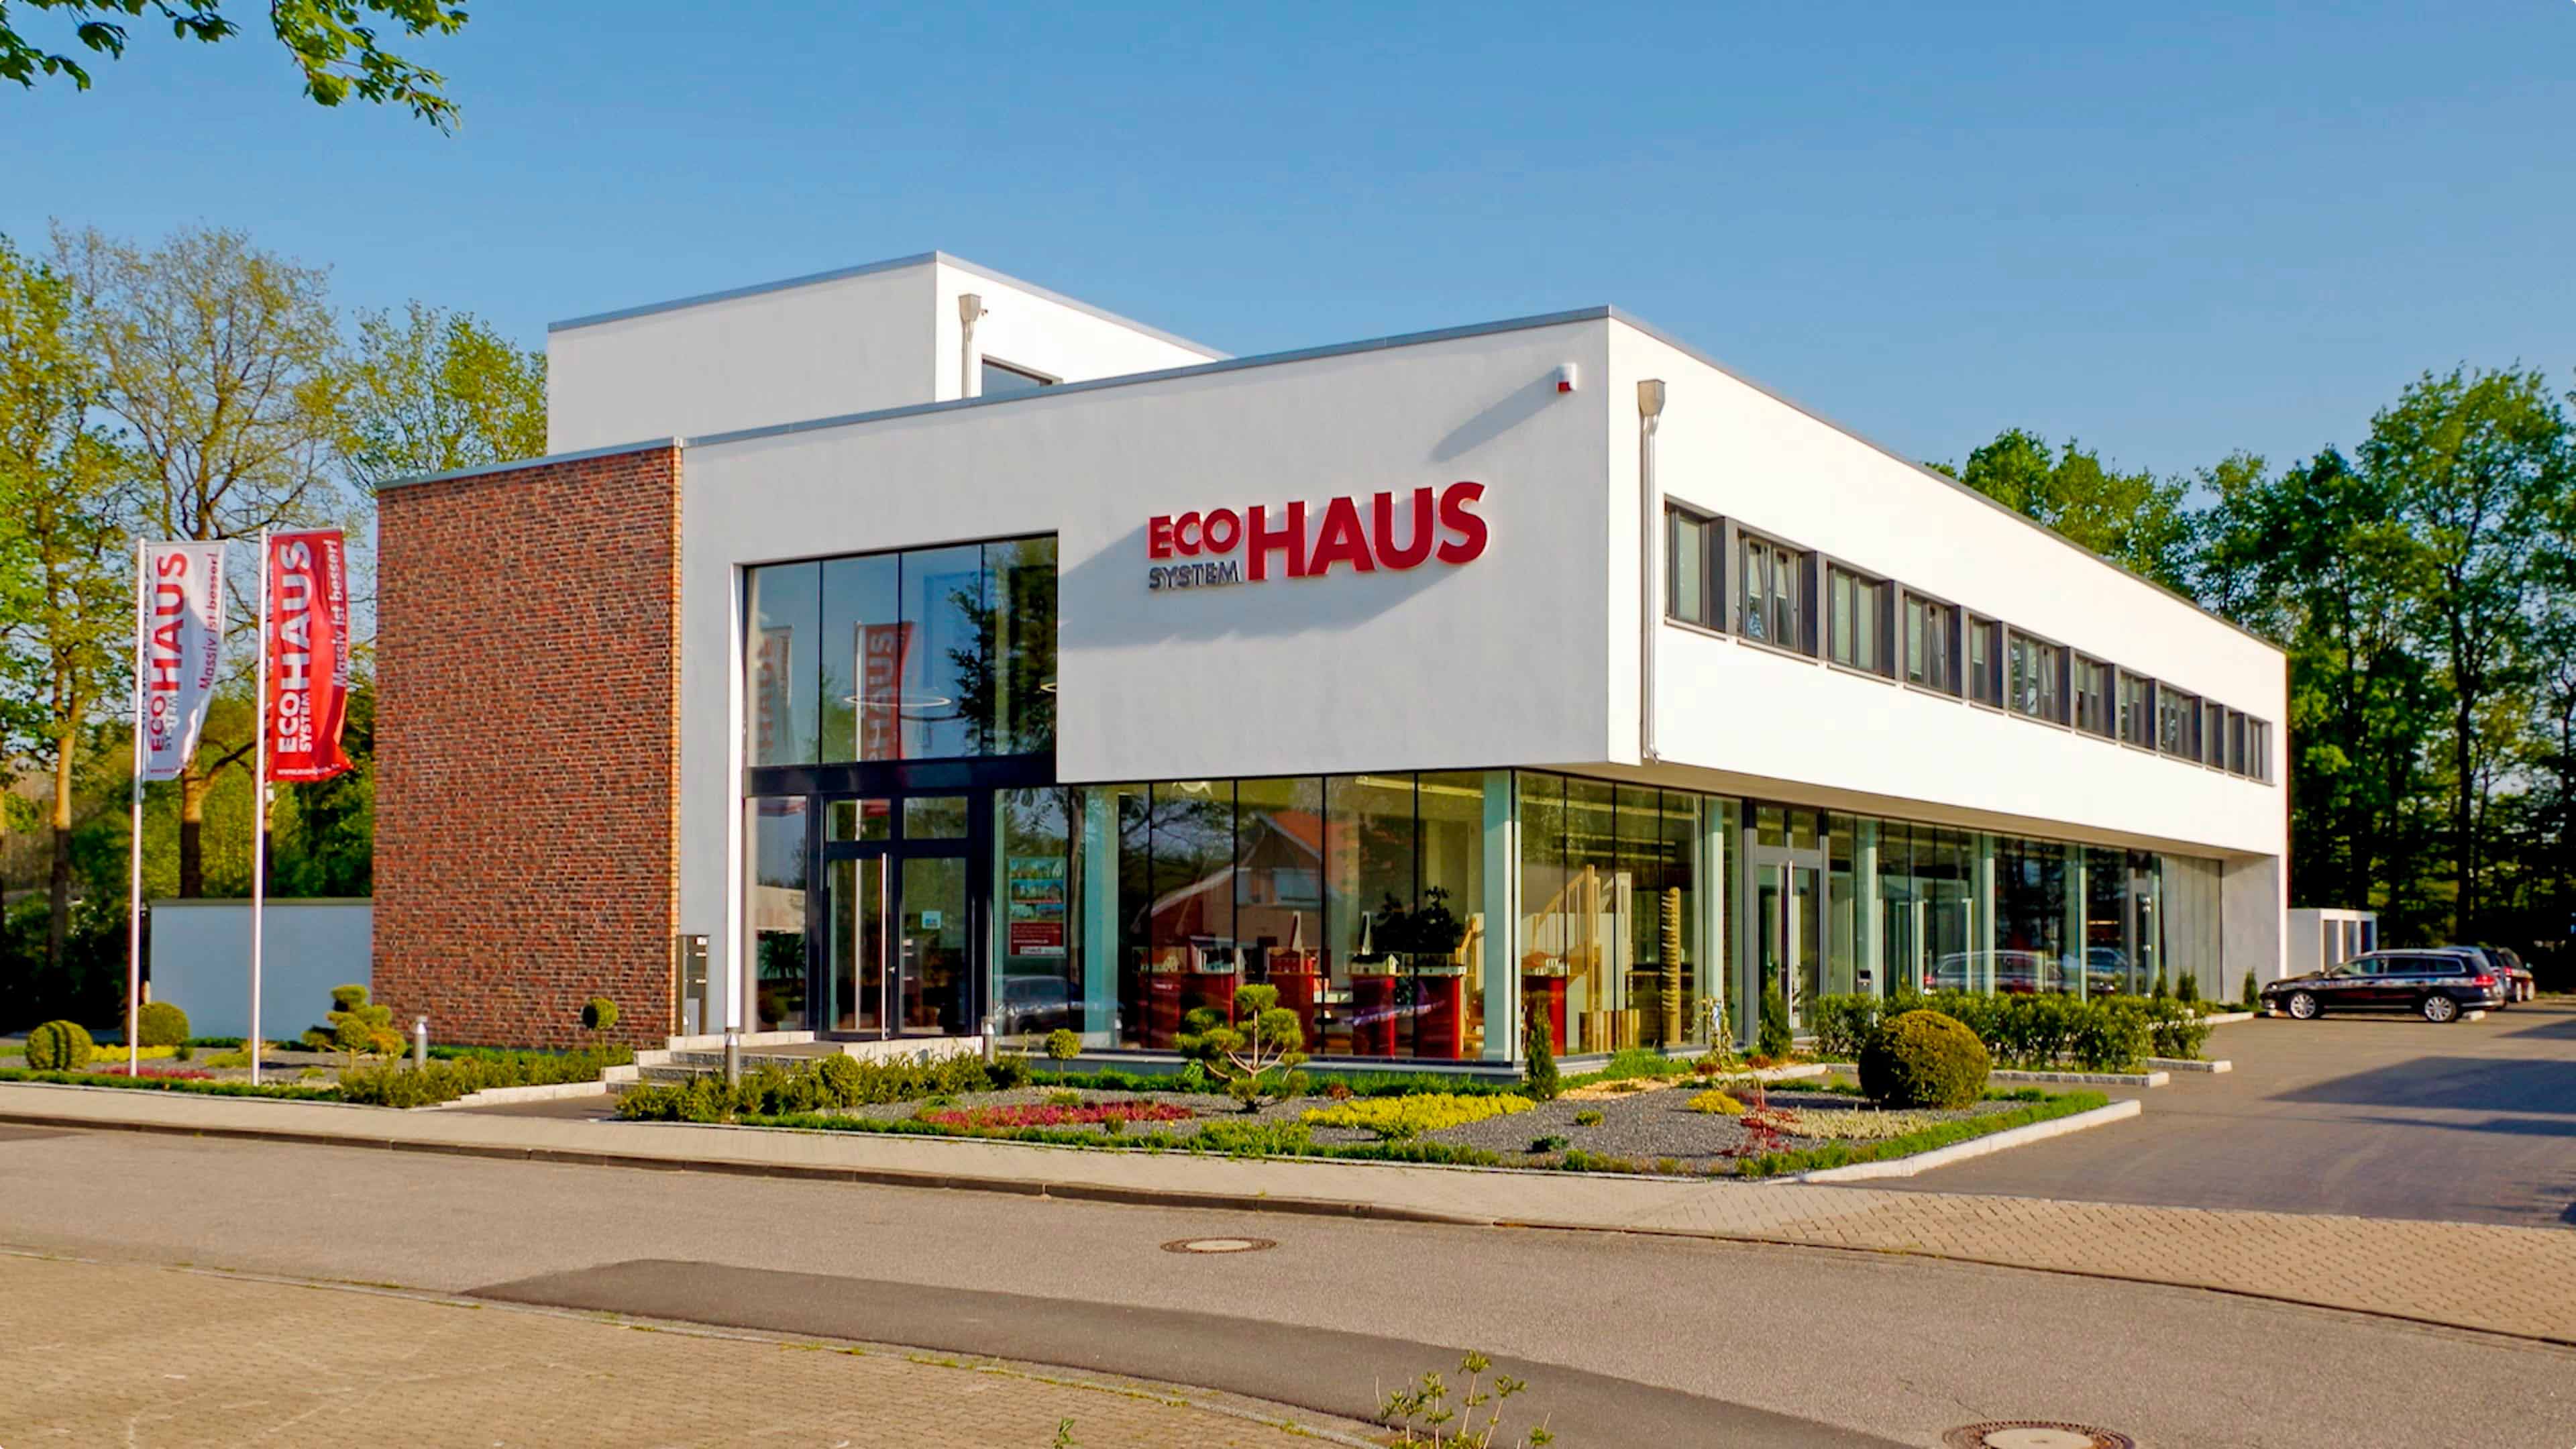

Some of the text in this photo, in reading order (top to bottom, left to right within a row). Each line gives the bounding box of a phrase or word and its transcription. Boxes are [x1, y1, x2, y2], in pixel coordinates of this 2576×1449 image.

[1148, 481, 1489, 582] ECO HAUS
[1148, 560, 1241, 590] SYSTEM
[150, 552, 189, 691] HAUS
[277, 540, 312, 753] ECO HAUS
[199, 638, 218, 689] Massiv
[331, 629, 347, 688] Massiv
[150, 695, 166, 752] ECO
[299, 691, 313, 753] SYSTEM
